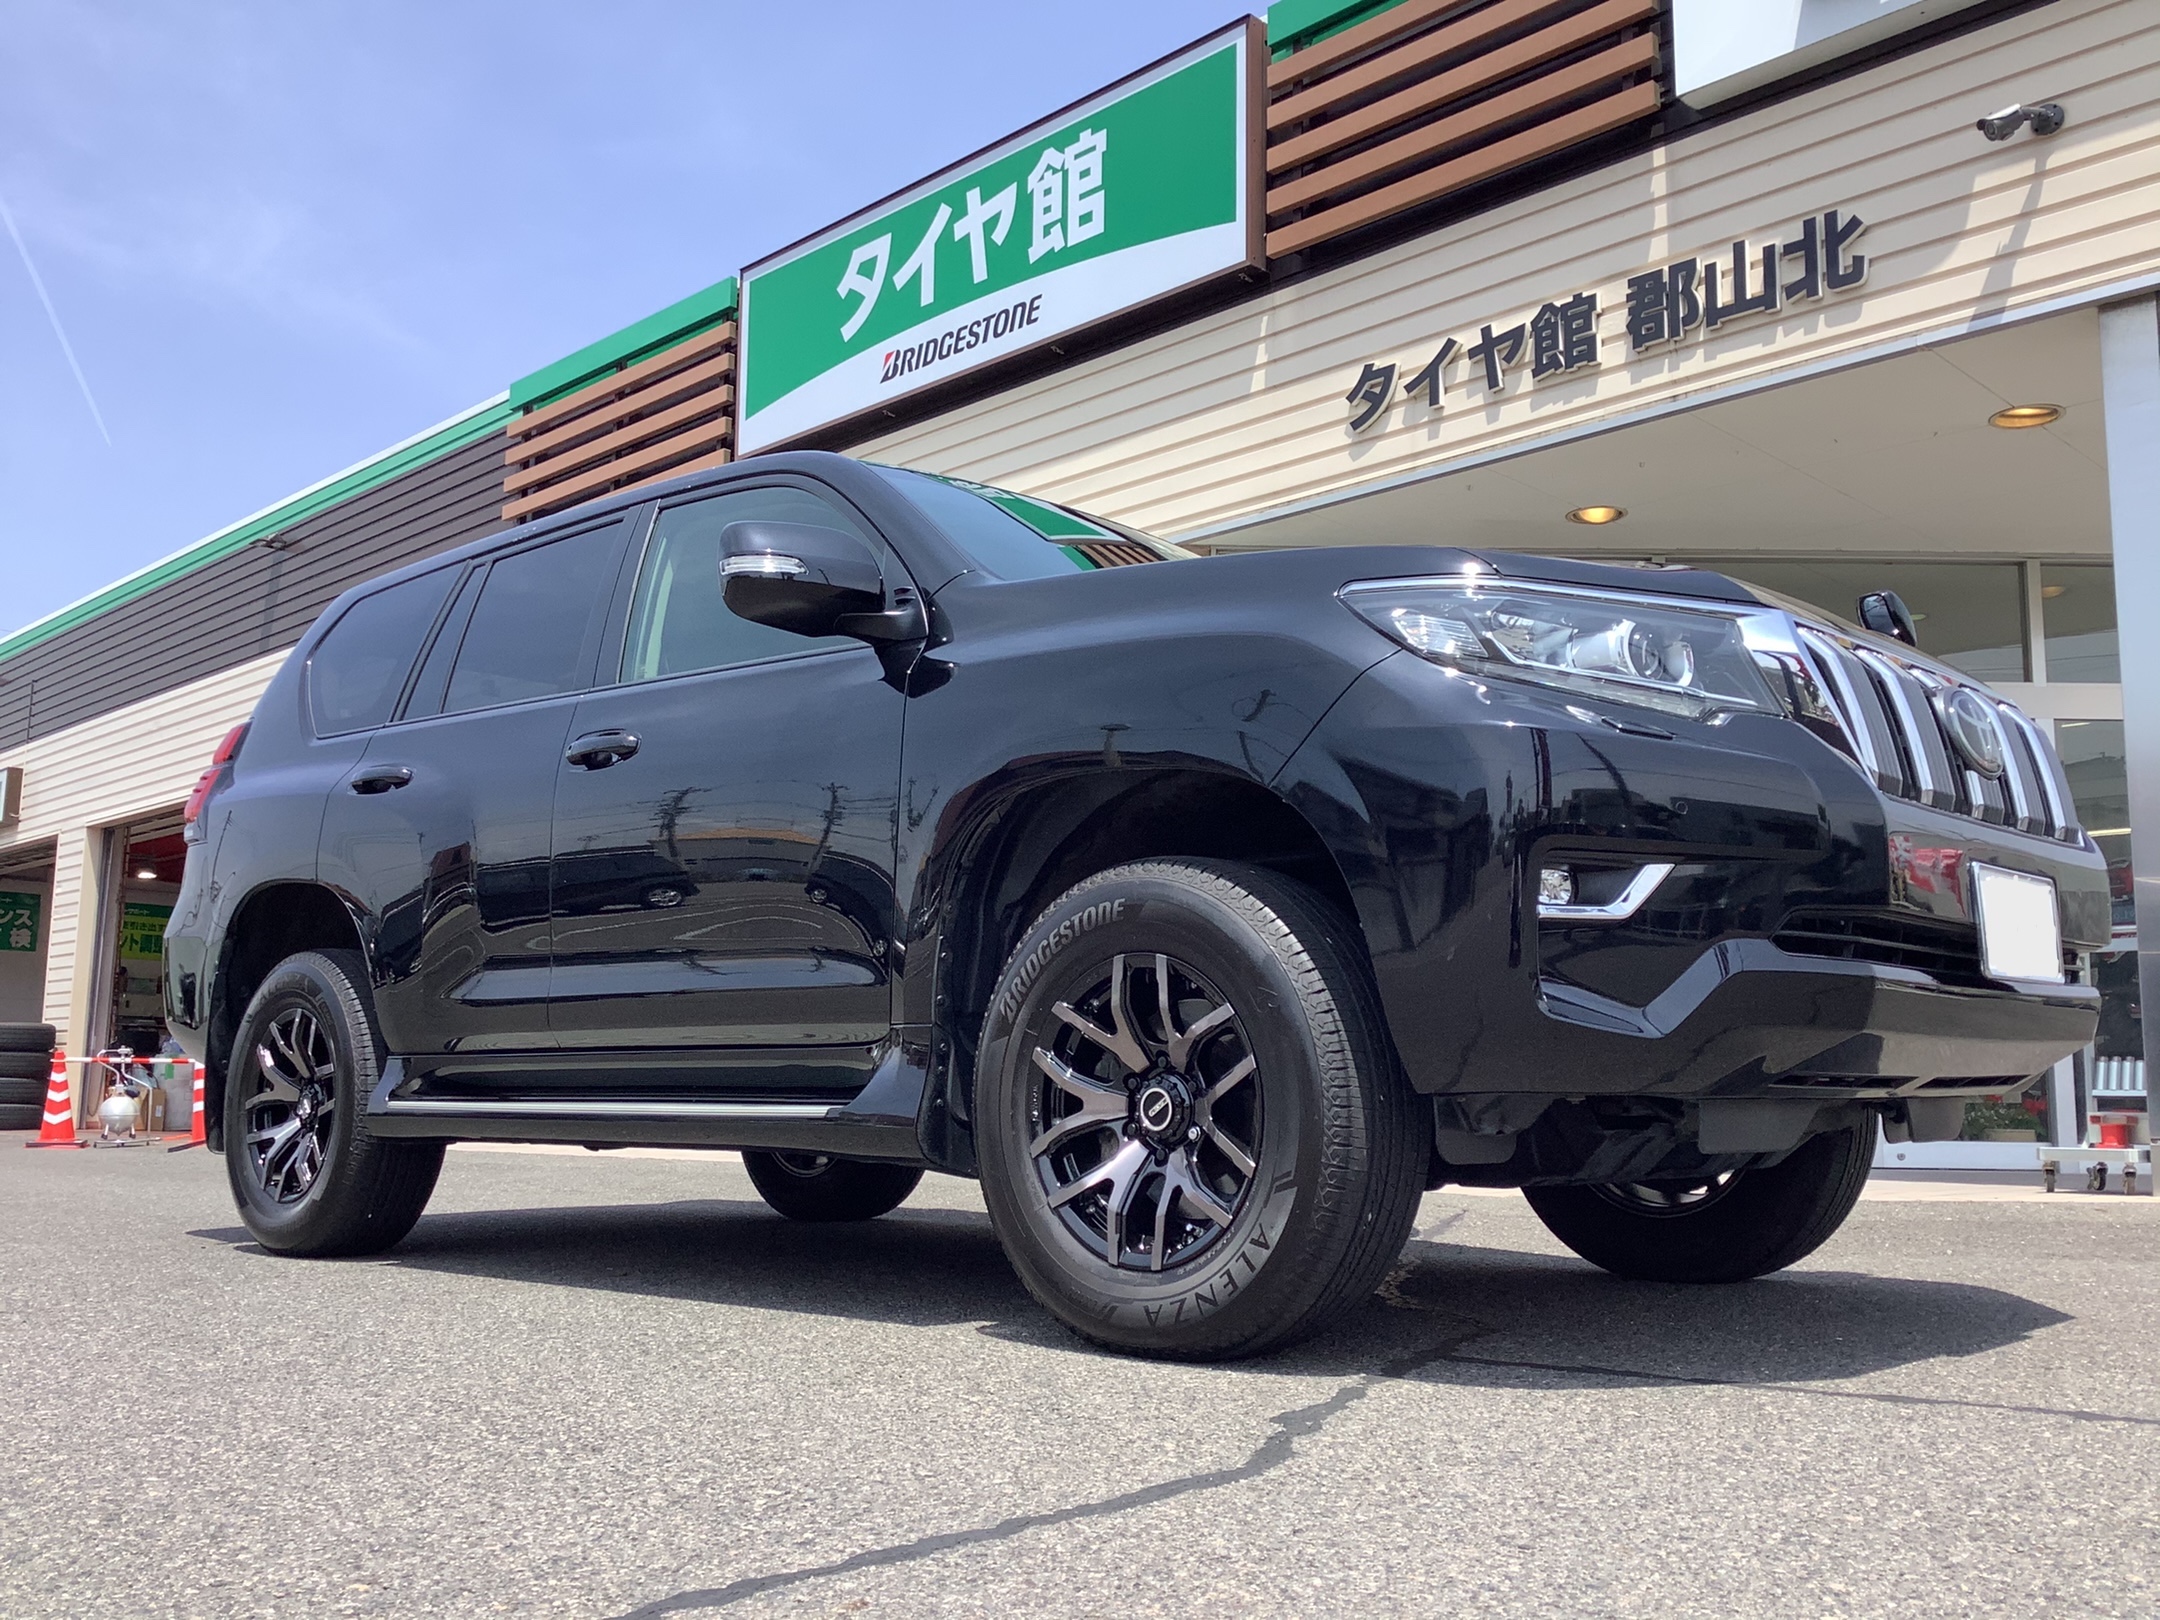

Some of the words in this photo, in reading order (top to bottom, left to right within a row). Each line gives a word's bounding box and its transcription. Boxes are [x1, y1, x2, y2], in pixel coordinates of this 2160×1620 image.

[836, 127, 1107, 343] タイヤ館
[880, 294, 1043, 384] BRIDGESTONE
[1345, 291, 1601, 433] タイヤ館
[1625, 209, 1868, 352] 郡山北
[1000, 898, 1125, 1024] BRIDGESTONE
[1143, 1223, 1270, 1327] ALENZA
